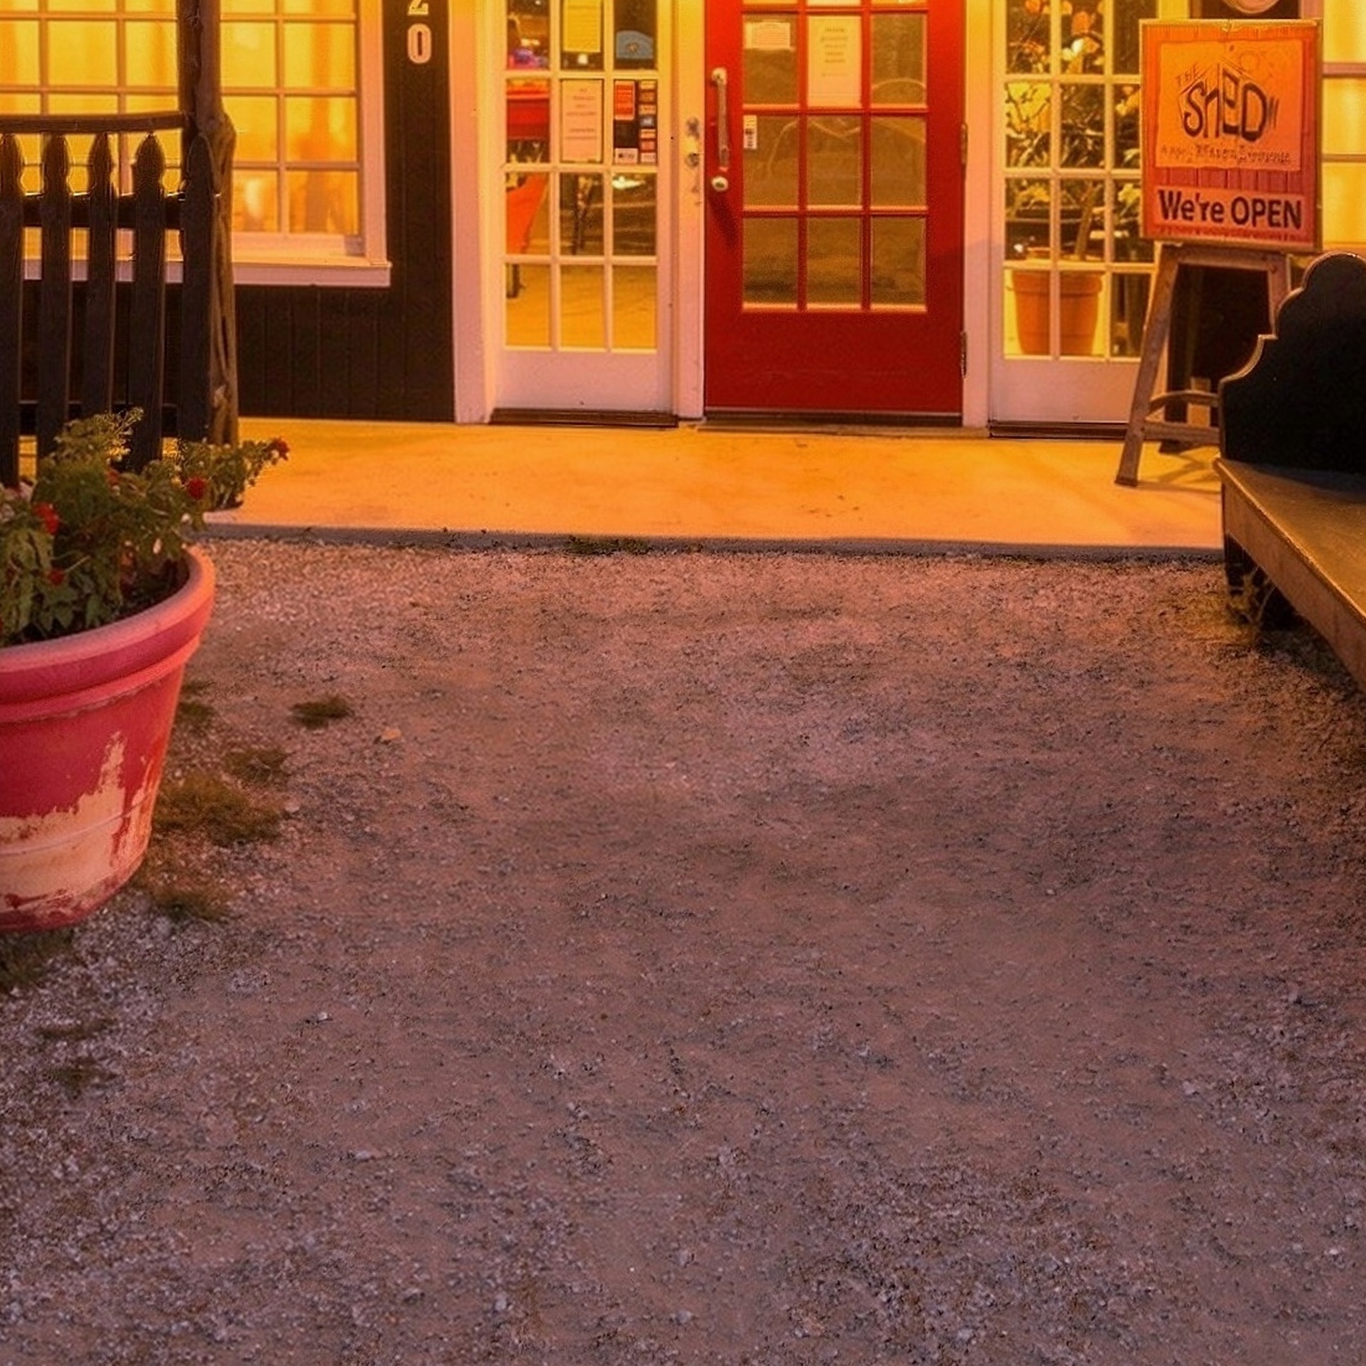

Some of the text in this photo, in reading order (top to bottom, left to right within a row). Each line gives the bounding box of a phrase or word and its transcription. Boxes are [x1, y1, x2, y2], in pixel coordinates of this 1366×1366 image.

[1183, 64, 1267, 142] SHED
[1158, 189, 1303, 229] We're OPEN
